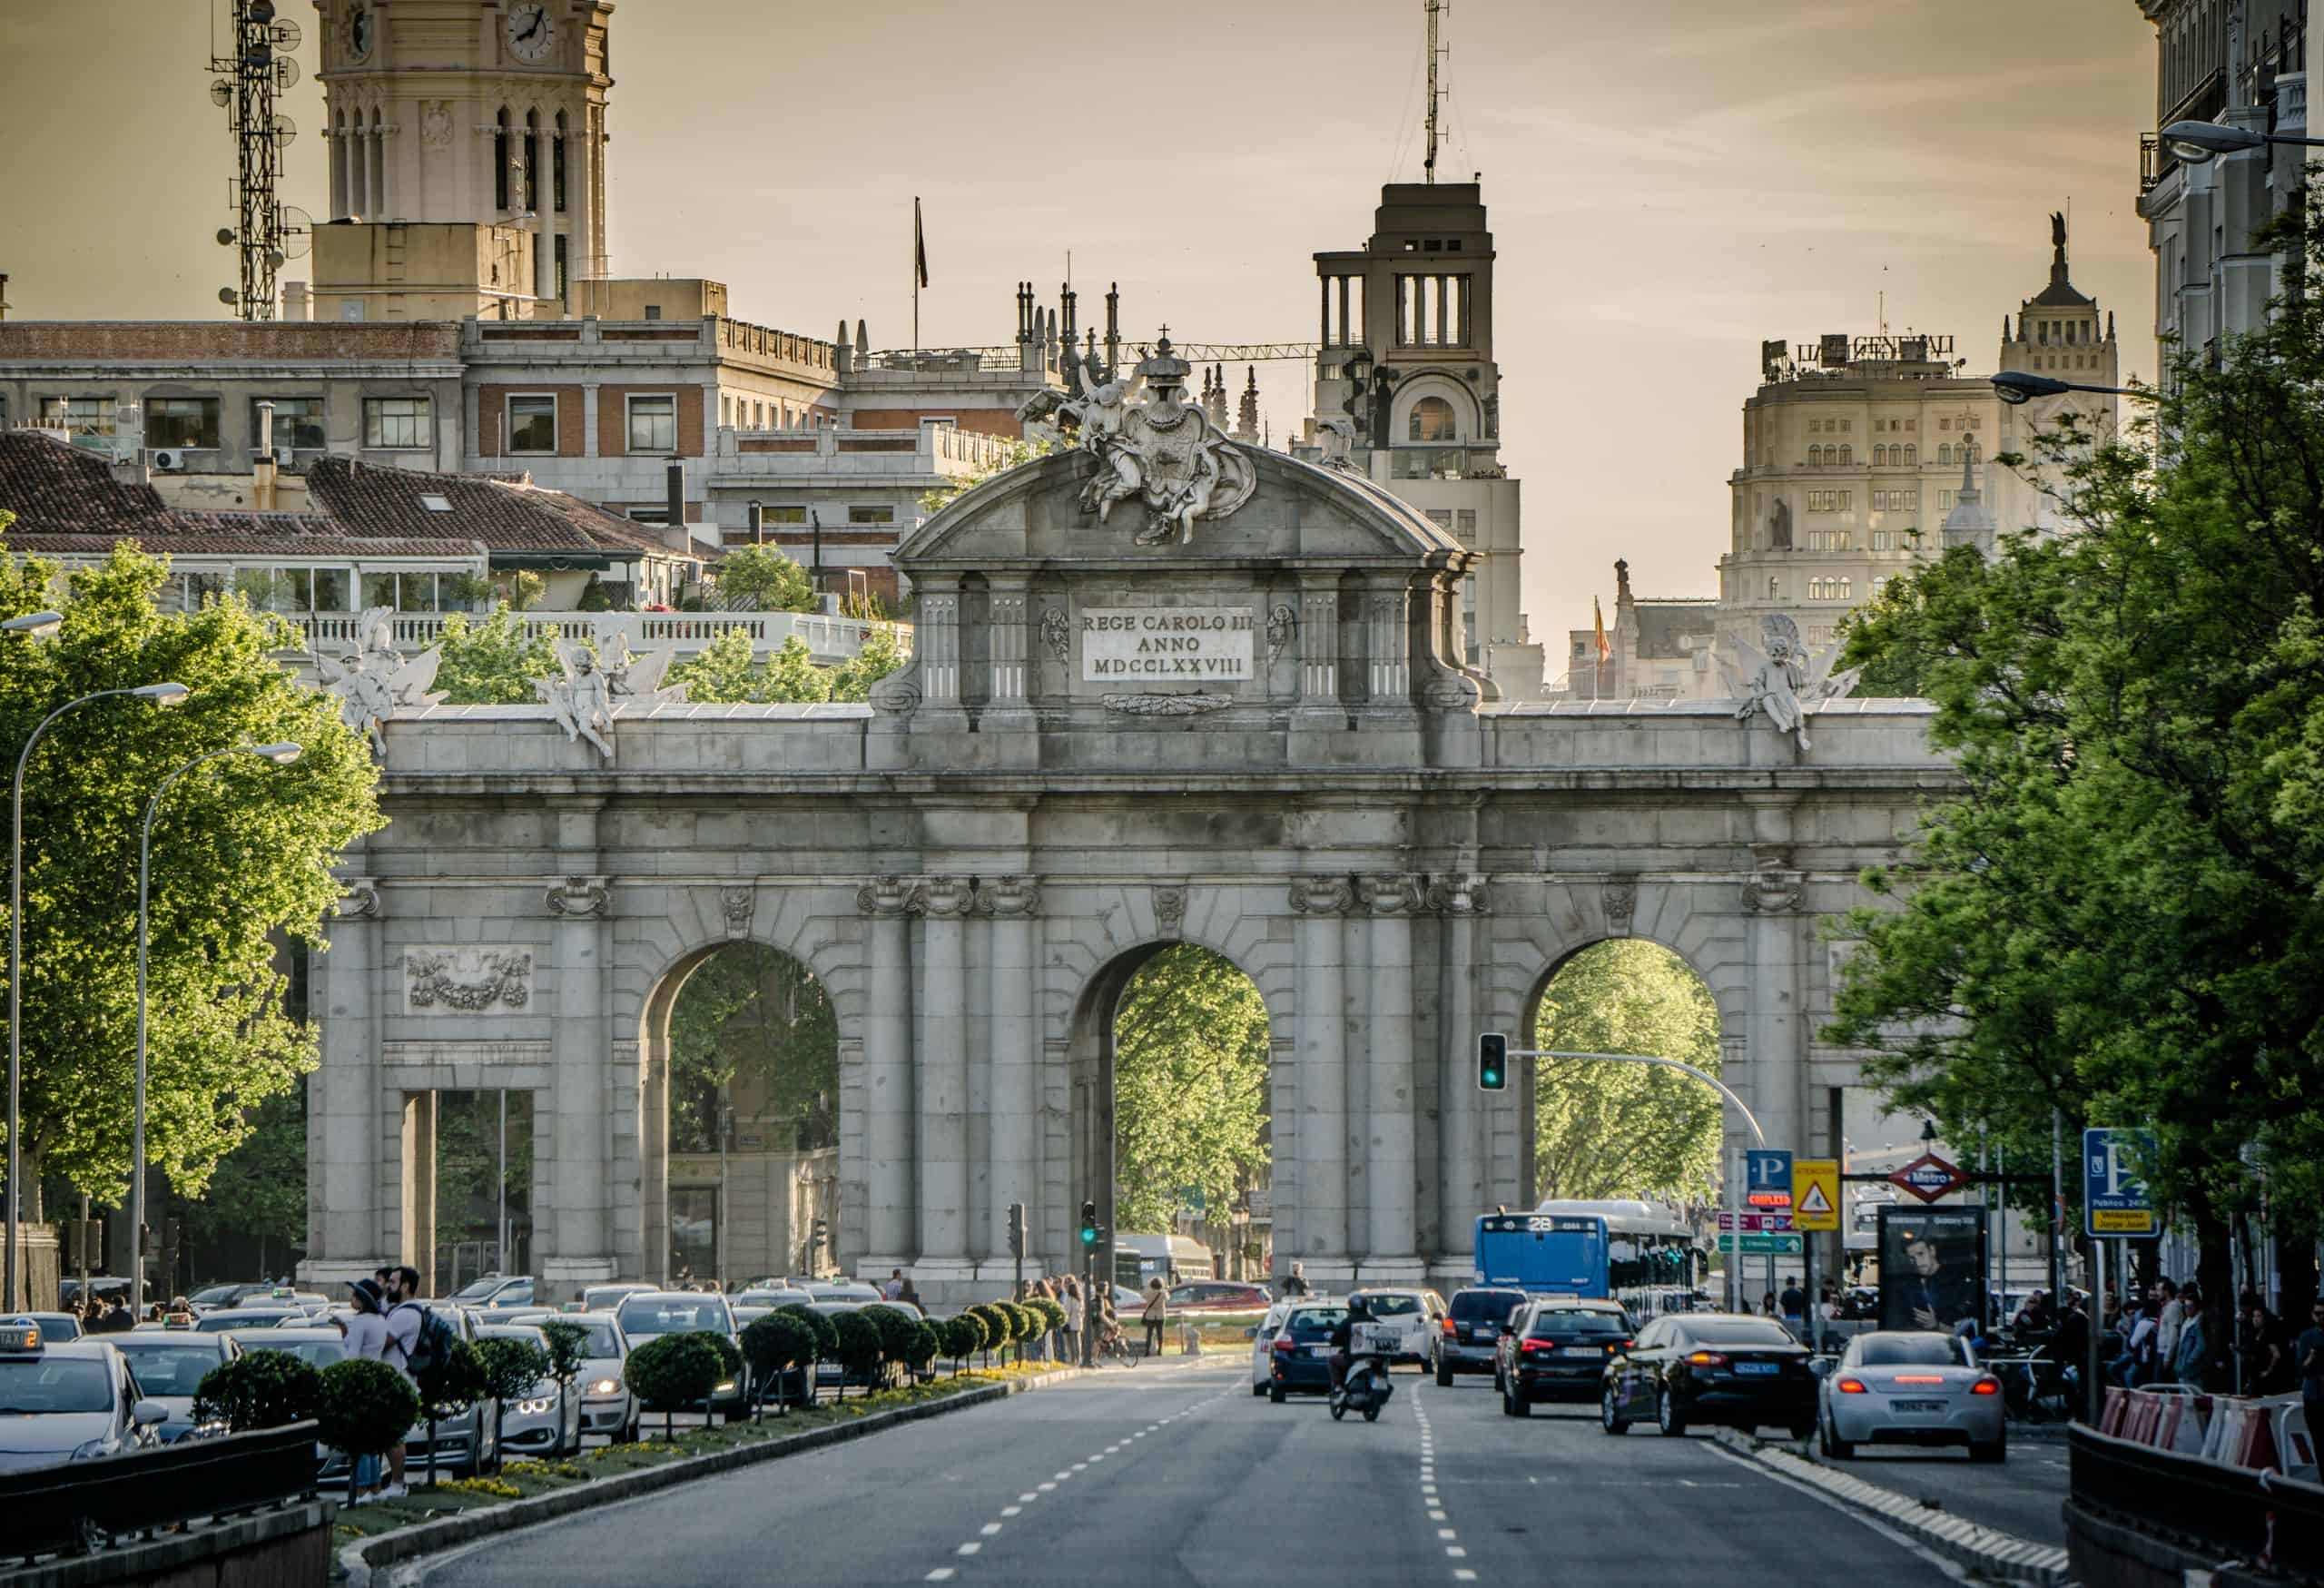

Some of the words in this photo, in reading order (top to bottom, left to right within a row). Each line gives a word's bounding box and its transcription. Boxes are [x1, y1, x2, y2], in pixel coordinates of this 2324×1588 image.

[1854, 336, 1954, 354] GENALI
[1084, 616, 1135, 630] REGE
[1143, 616, 1225, 630] CAROLO
[1232, 616, 1254, 630] III
[1137, 637, 1199, 652] ANNO
[1095, 659, 1242, 673] MDCCLXXVIII
[1758, 1158, 1785, 1185] P
[1912, 1171, 1947, 1184] Metro
[0, 1333, 25, 1345] TAXI
[28, 1330, 37, 1348] 2
